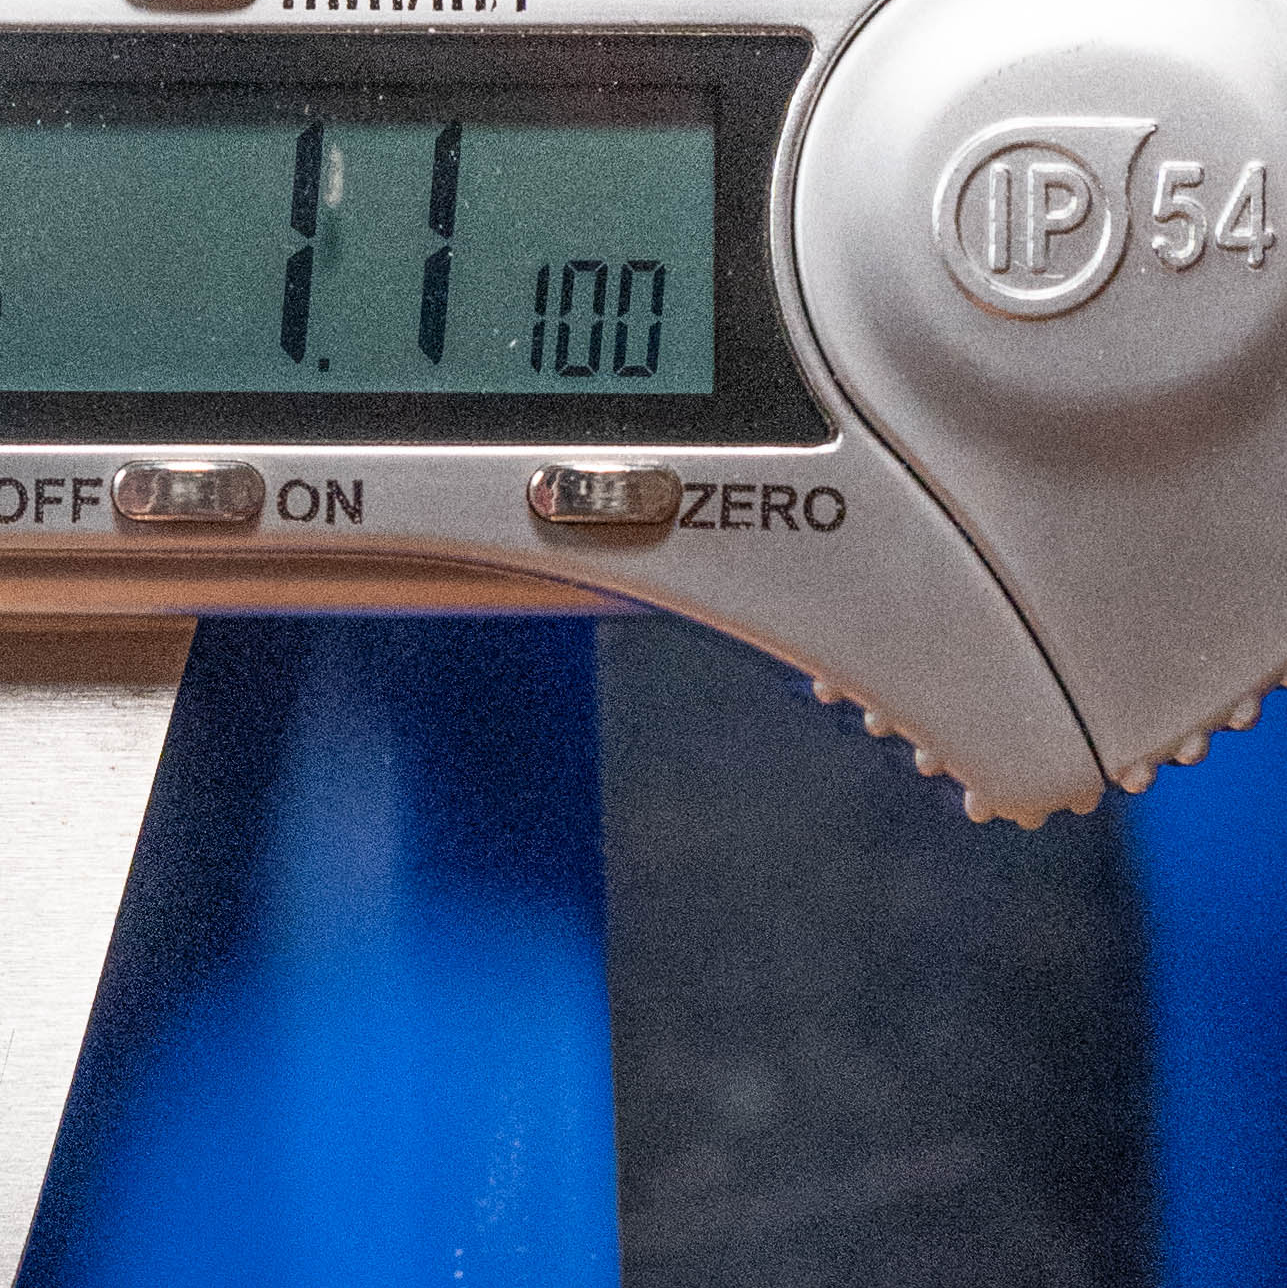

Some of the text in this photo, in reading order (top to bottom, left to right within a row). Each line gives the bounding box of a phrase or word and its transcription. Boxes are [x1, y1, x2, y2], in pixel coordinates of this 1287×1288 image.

[988, 161, 1276, 274] IP 54
[276, 476, 364, 526] ON
[679, 482, 848, 533] ZERO
